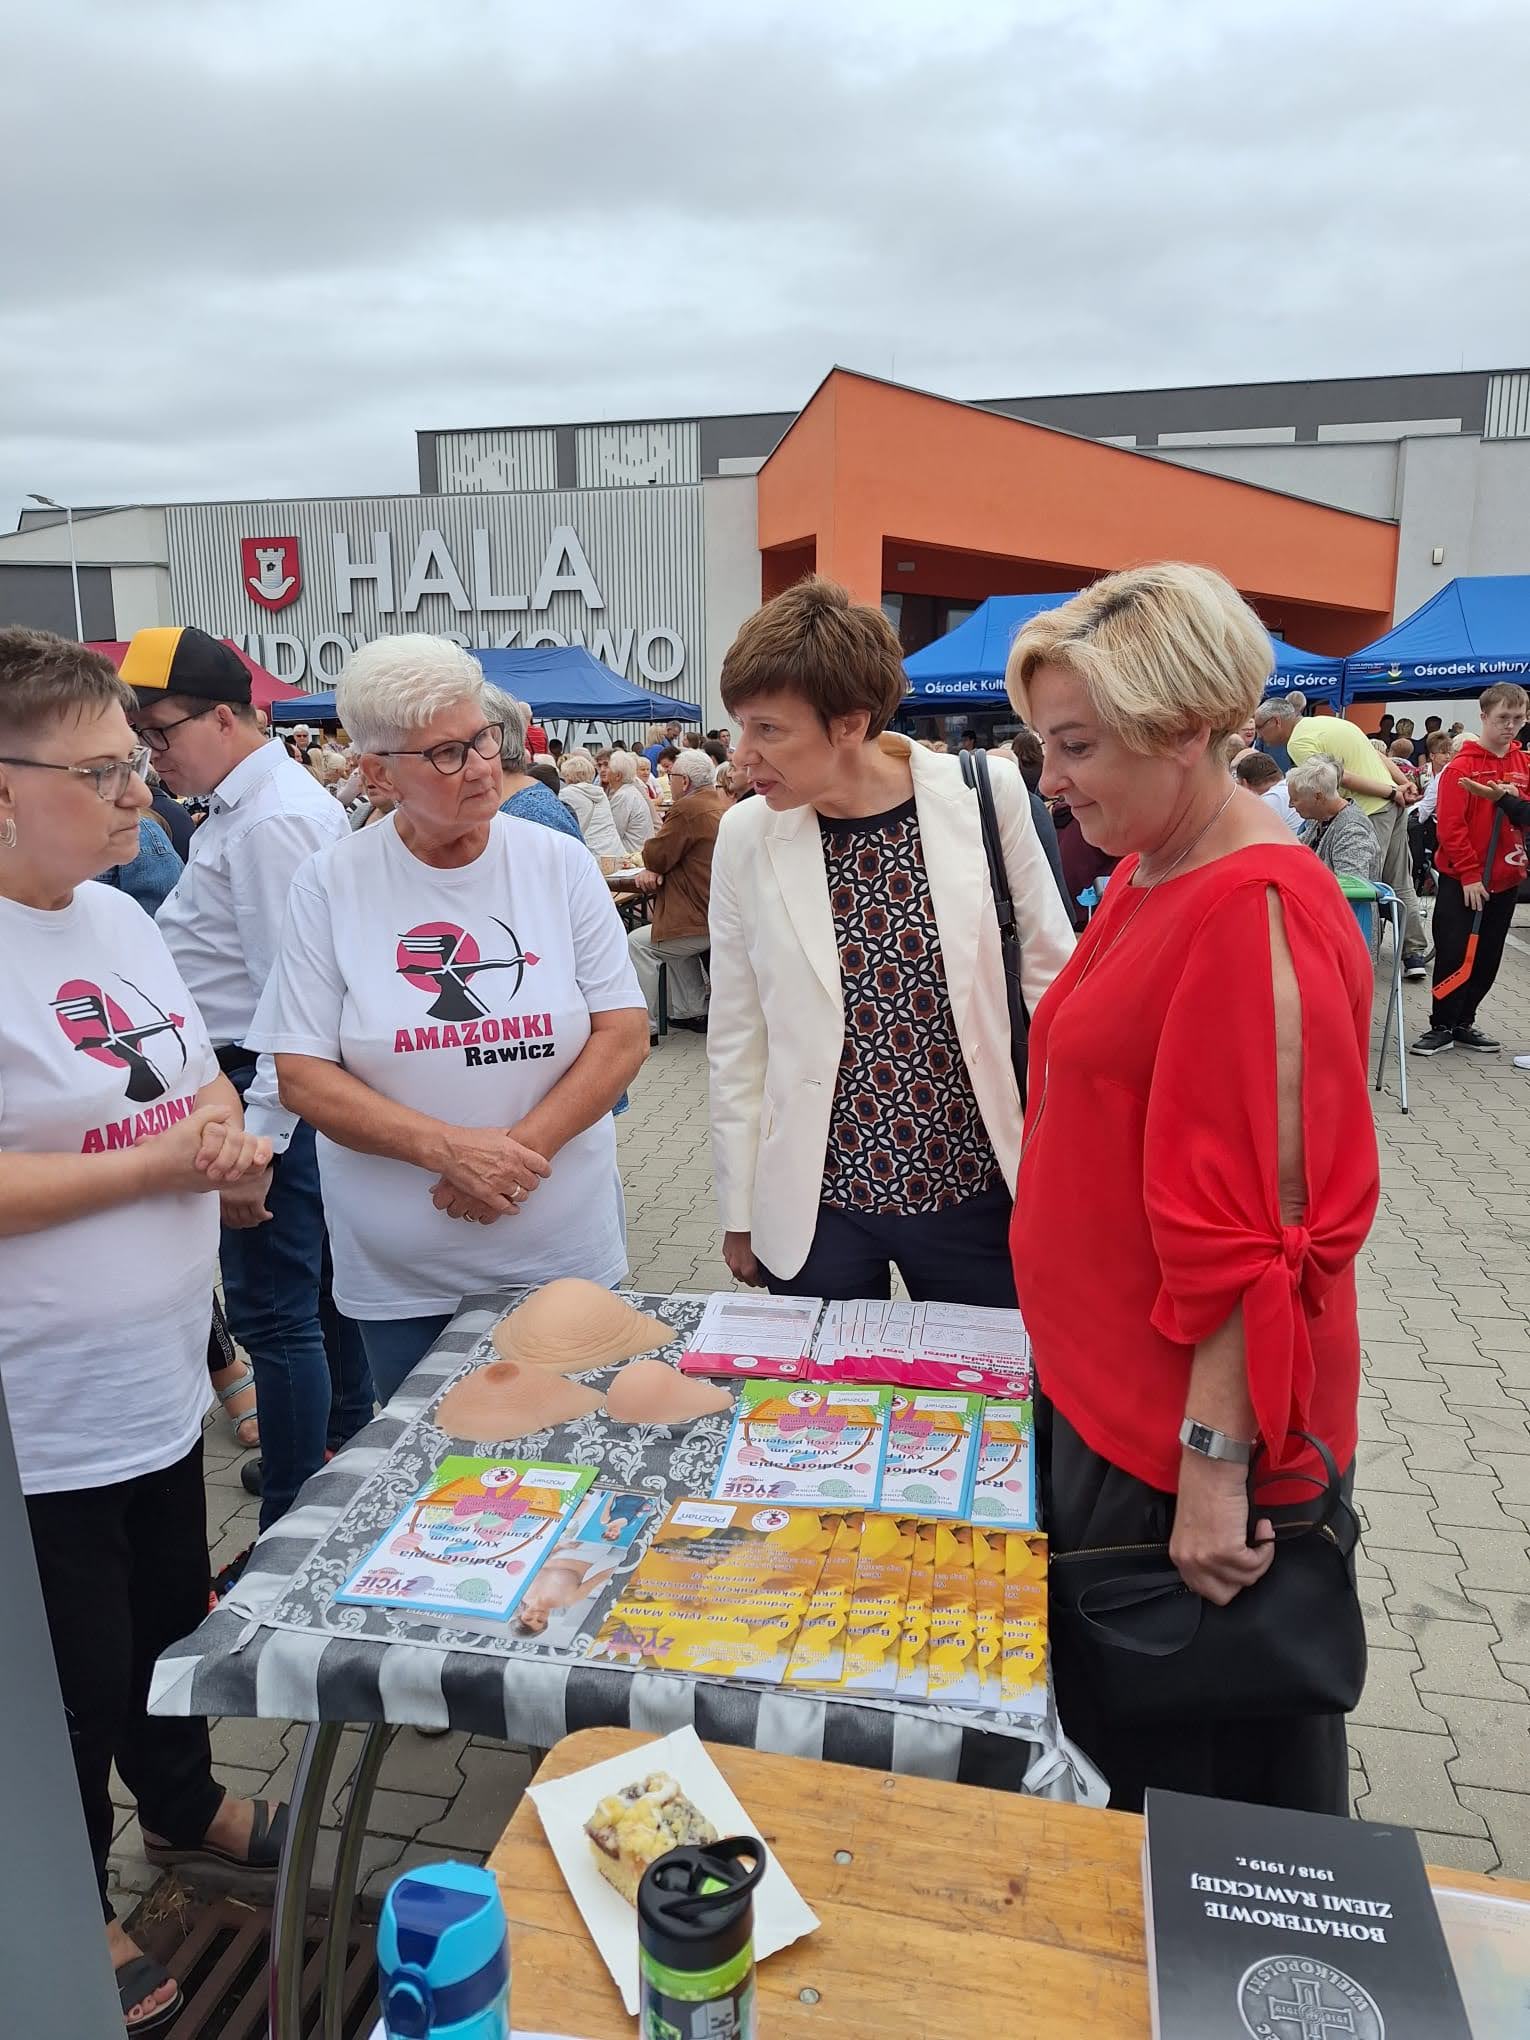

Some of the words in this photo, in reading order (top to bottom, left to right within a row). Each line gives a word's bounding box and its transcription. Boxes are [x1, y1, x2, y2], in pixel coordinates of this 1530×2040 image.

[332, 525, 606, 613] HALA
[1414, 662, 1476, 677] Ośrodek
[1293, 672, 1338, 686] Górce
[925, 680, 978, 694] Ośrodek
[393, 1013, 554, 1054] AMAZONKI
[463, 1040, 555, 1067] Rawicz
[769, 1447, 807, 1456] Forum
[749, 1460, 854, 1472] Radioterapia
[430, 1535, 470, 1545] Forum
[399, 1548, 508, 1571] Radioterapia
[352, 1587, 411, 1598] NASZE
[620, 1606, 664, 1617] MAMY
[668, 1610, 703, 1622] tylko
[706, 1614, 728, 1623] nie
[1235, 1856, 1248, 1868] r.
[1250, 1858, 1285, 1874] 1919
[1298, 1866, 1335, 1882] 1918
[1189, 1872, 1319, 1908] RAWICKIEJ
[1321, 1894, 1394, 1919] ZIEMI
[1204, 1901, 1388, 1944] BOHATEROWIE
